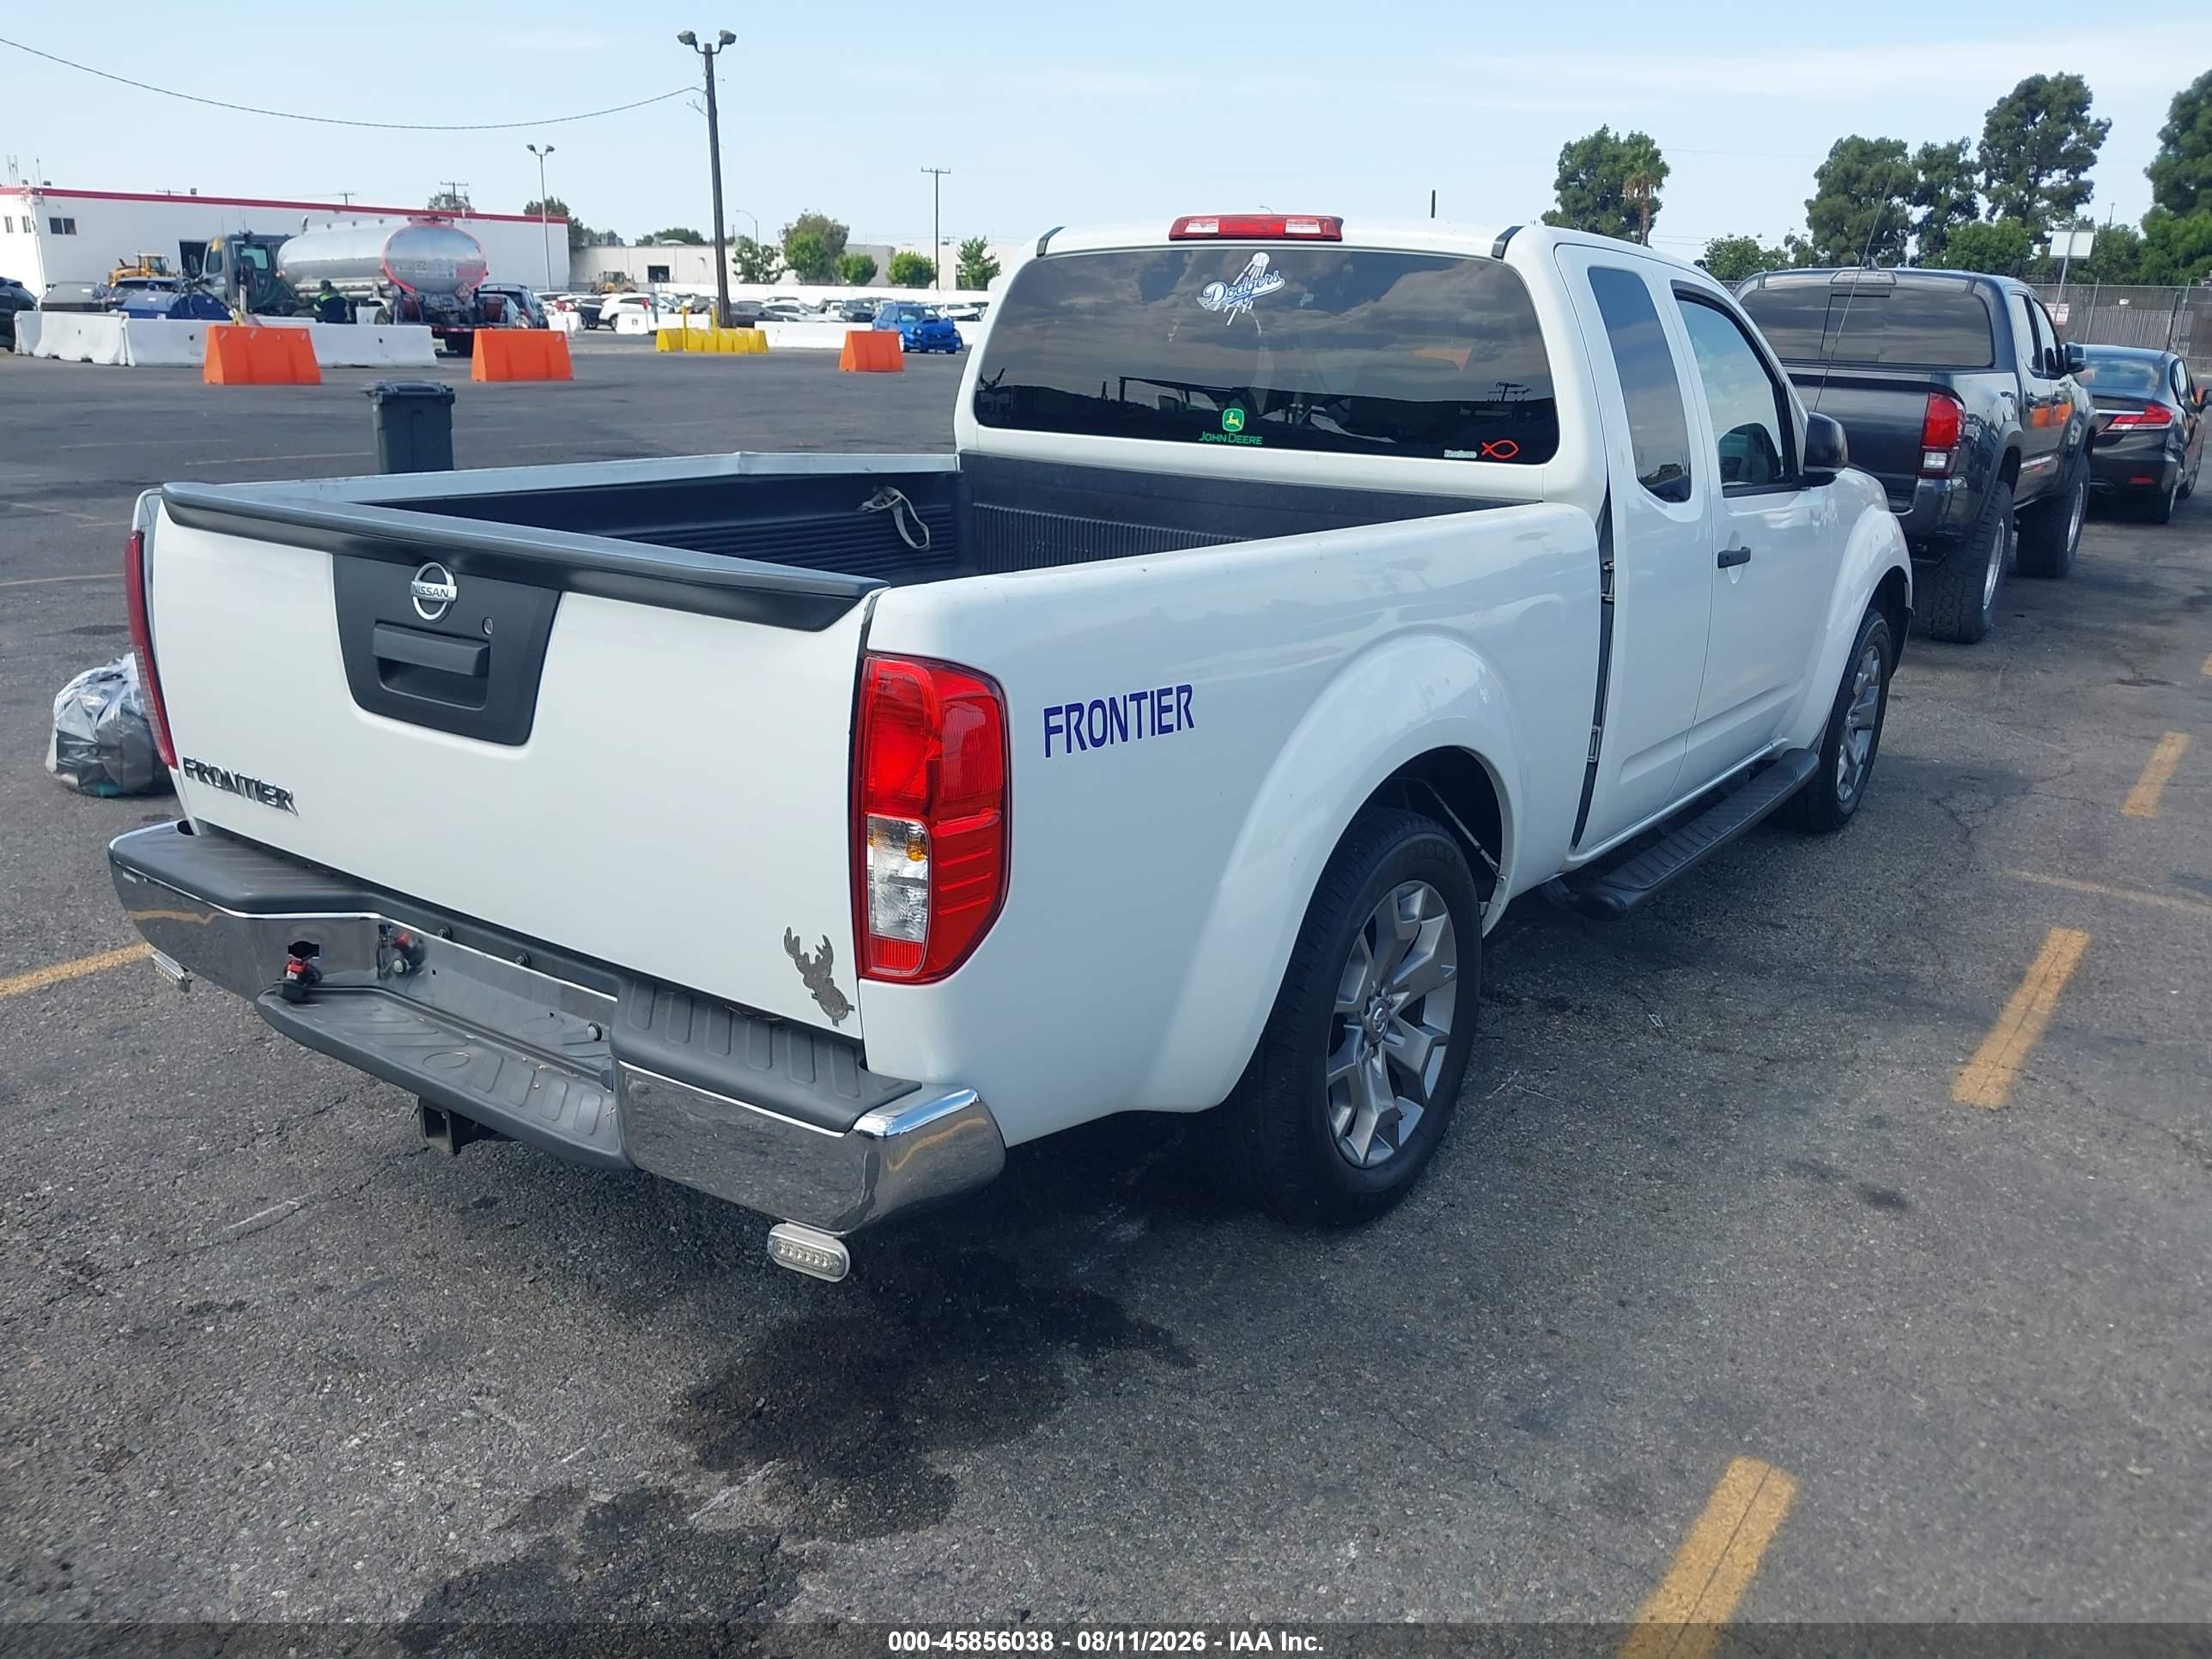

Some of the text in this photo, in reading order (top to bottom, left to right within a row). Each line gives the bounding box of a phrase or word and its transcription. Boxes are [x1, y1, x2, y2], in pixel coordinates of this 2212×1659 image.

[1202, 270, 1285, 306] Dodgers
[1199, 431, 1263, 445] JOHN DEERE
[412, 584, 449, 599] NISSAN
[1043, 684, 1194, 758] FRONTIER
[183, 756, 299, 816] FRONTIER
